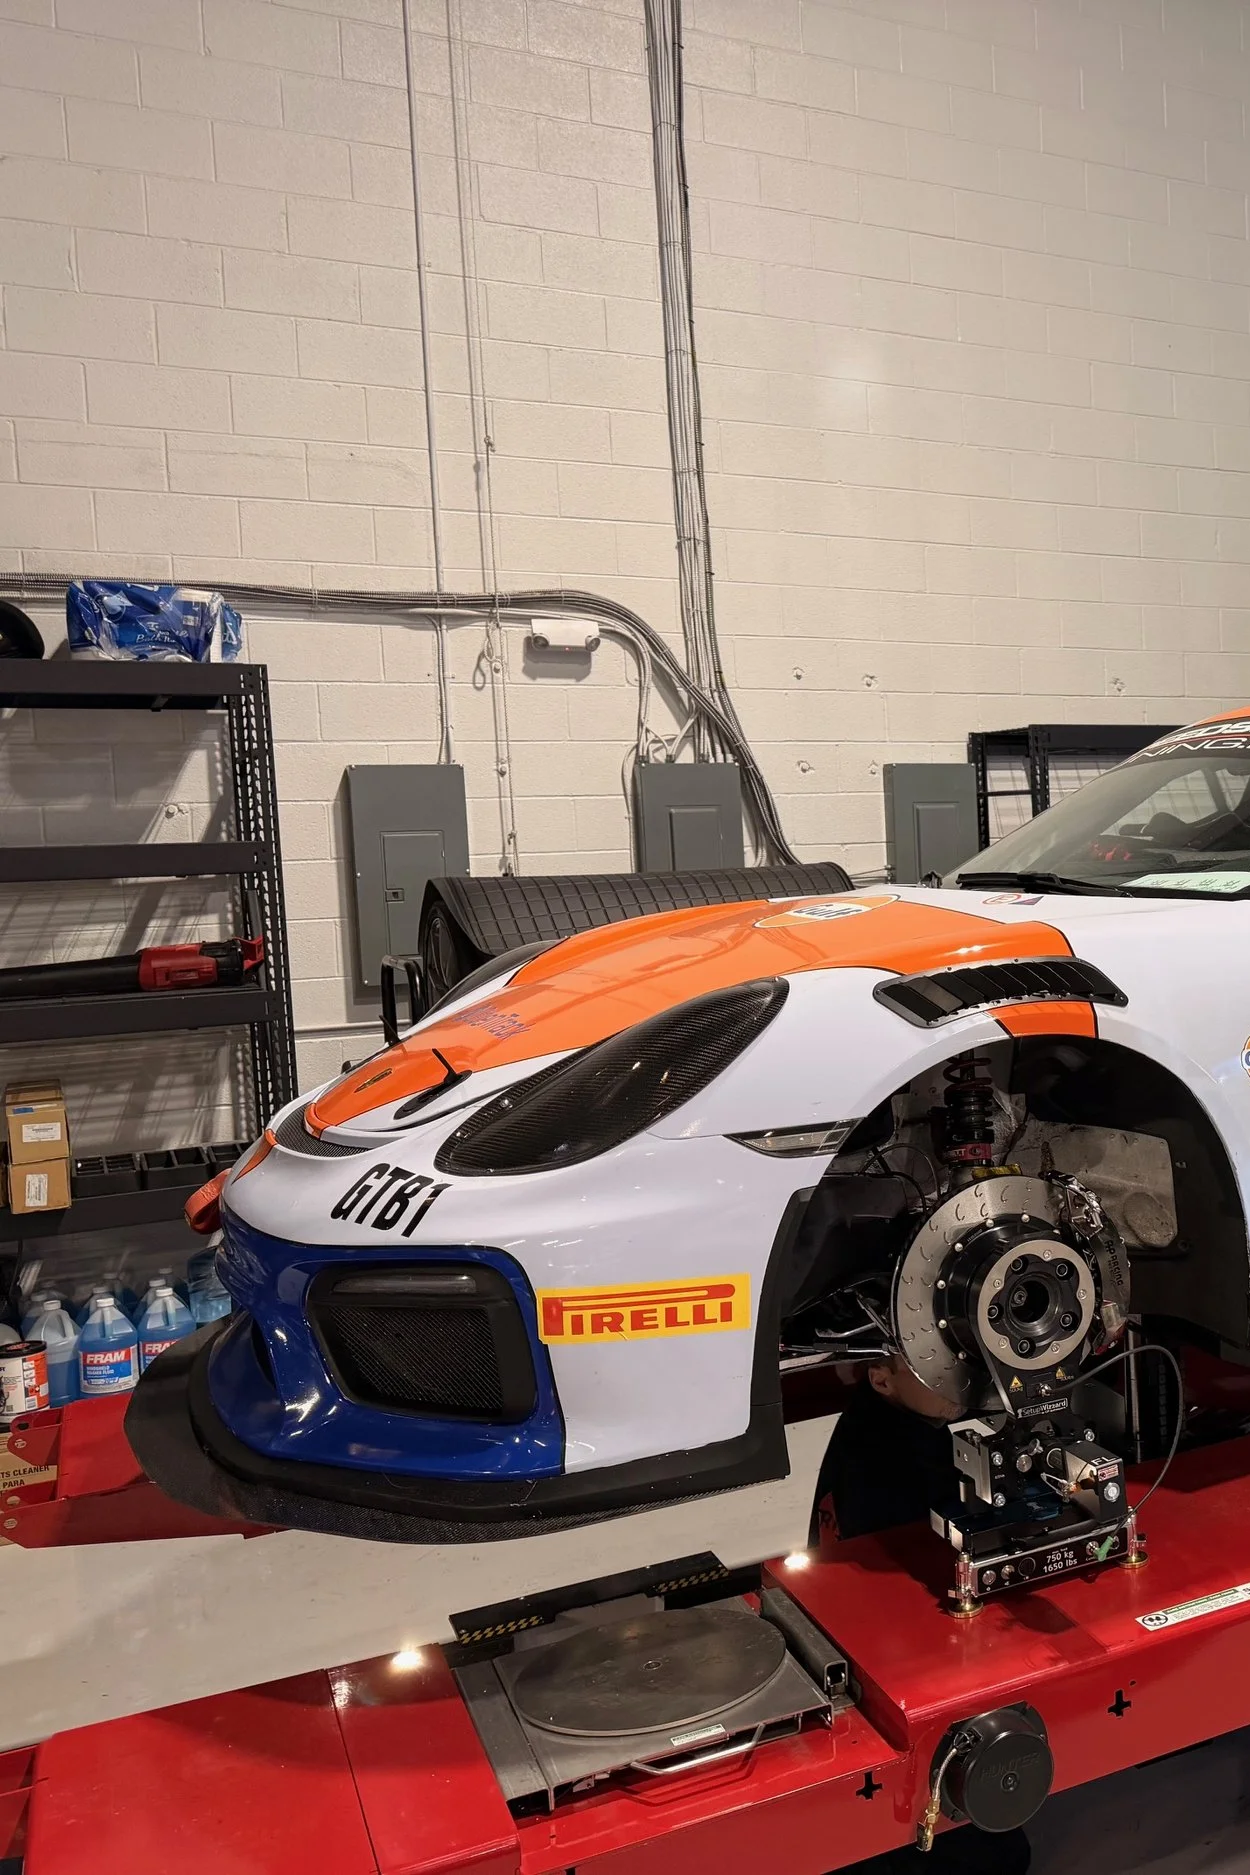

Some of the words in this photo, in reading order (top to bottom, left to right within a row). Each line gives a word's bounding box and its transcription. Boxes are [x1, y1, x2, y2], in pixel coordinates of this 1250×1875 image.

[330, 1163, 454, 1238] GTB1
[542, 1283, 736, 1336] PIRELLI
[145, 1340, 175, 1354] FRA
[86, 1350, 126, 1365] FRAM
[1091, 1456, 1117, 1466] FL
[13, 1465, 50, 1477] CLEANER
[2, 1479, 25, 1489] PARA
[1046, 1552, 1062, 1564] 750
[1064, 1549, 1075, 1560] kg
[1043, 1562, 1064, 1574] 1650
[1065, 1559, 1078, 1568] lbs
